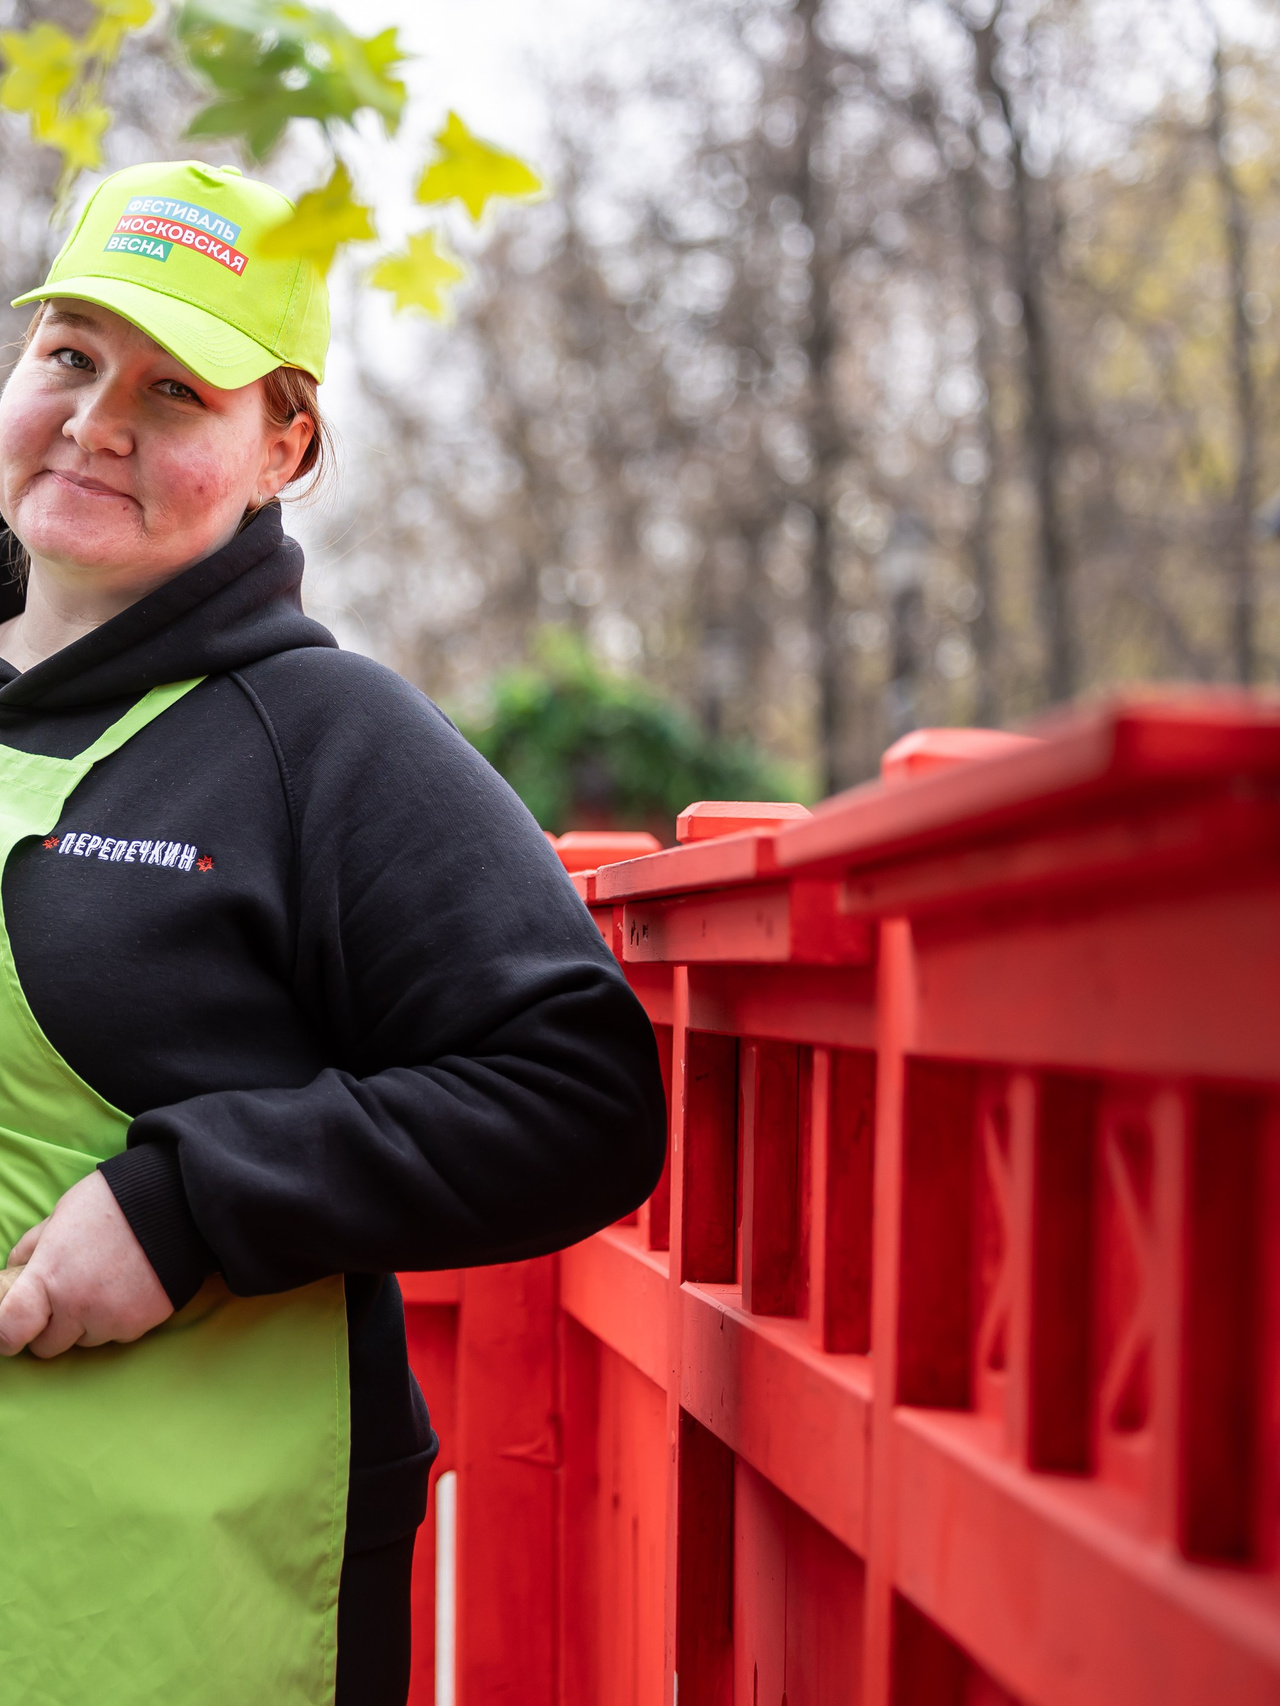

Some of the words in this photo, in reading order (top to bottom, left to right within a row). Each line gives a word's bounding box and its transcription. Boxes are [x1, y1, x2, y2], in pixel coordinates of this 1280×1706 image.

[129, 200, 235, 241] ФЕСТИВАЛЬ
[107, 237, 164, 259] ВЕСНА
[117, 218, 245, 272] МОСКОВСКАЯ
[58, 832, 198, 872] ПЕРЕПЕЧКИН
